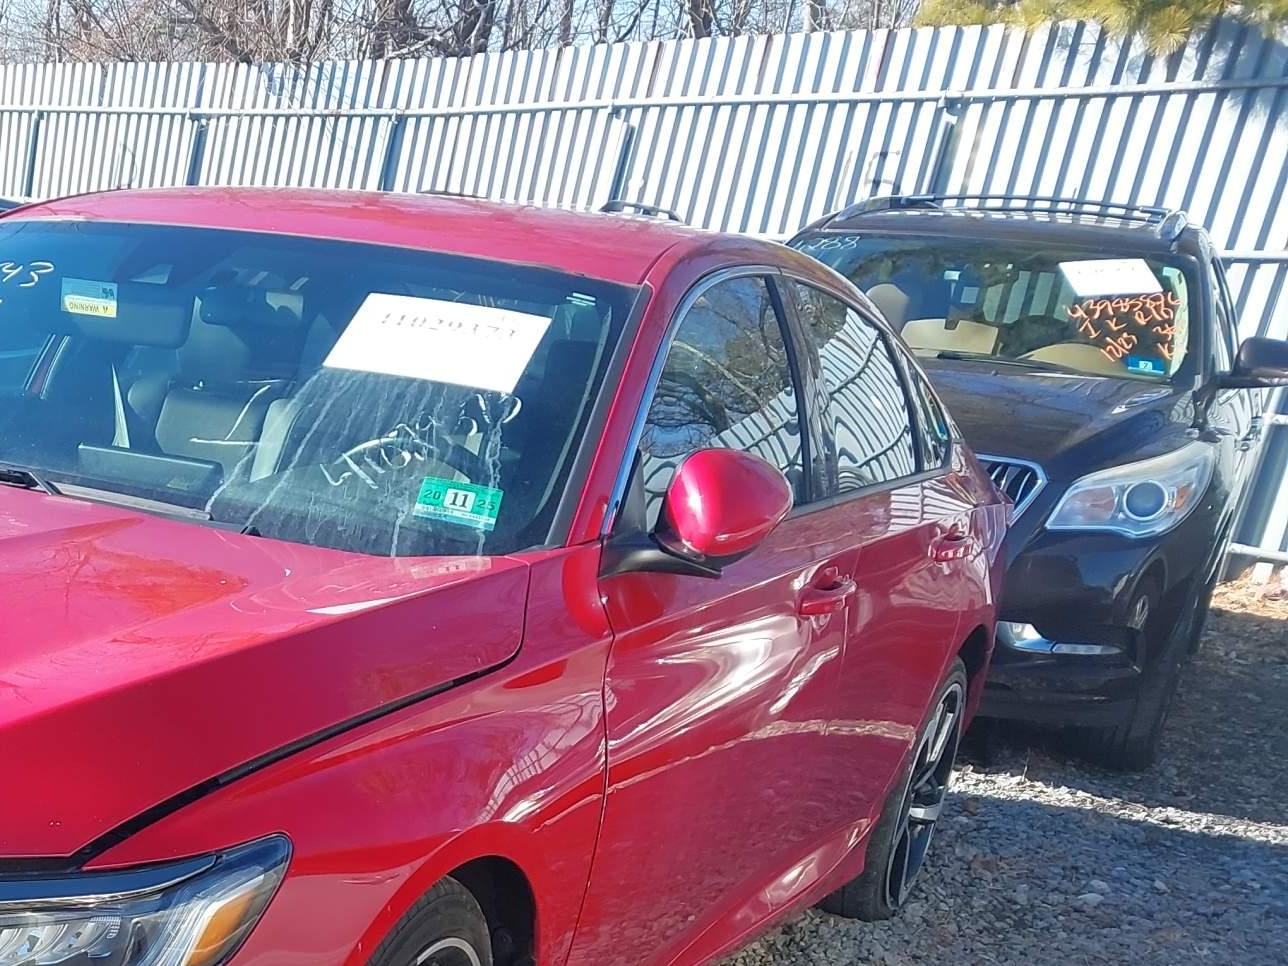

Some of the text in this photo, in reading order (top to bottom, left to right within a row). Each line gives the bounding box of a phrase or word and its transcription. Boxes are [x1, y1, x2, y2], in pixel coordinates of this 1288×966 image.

[68, 302, 100, 313] WARNING
[423, 488, 442, 501] 20
[448, 491, 470, 509] 11
[476, 499, 496, 512] 25
